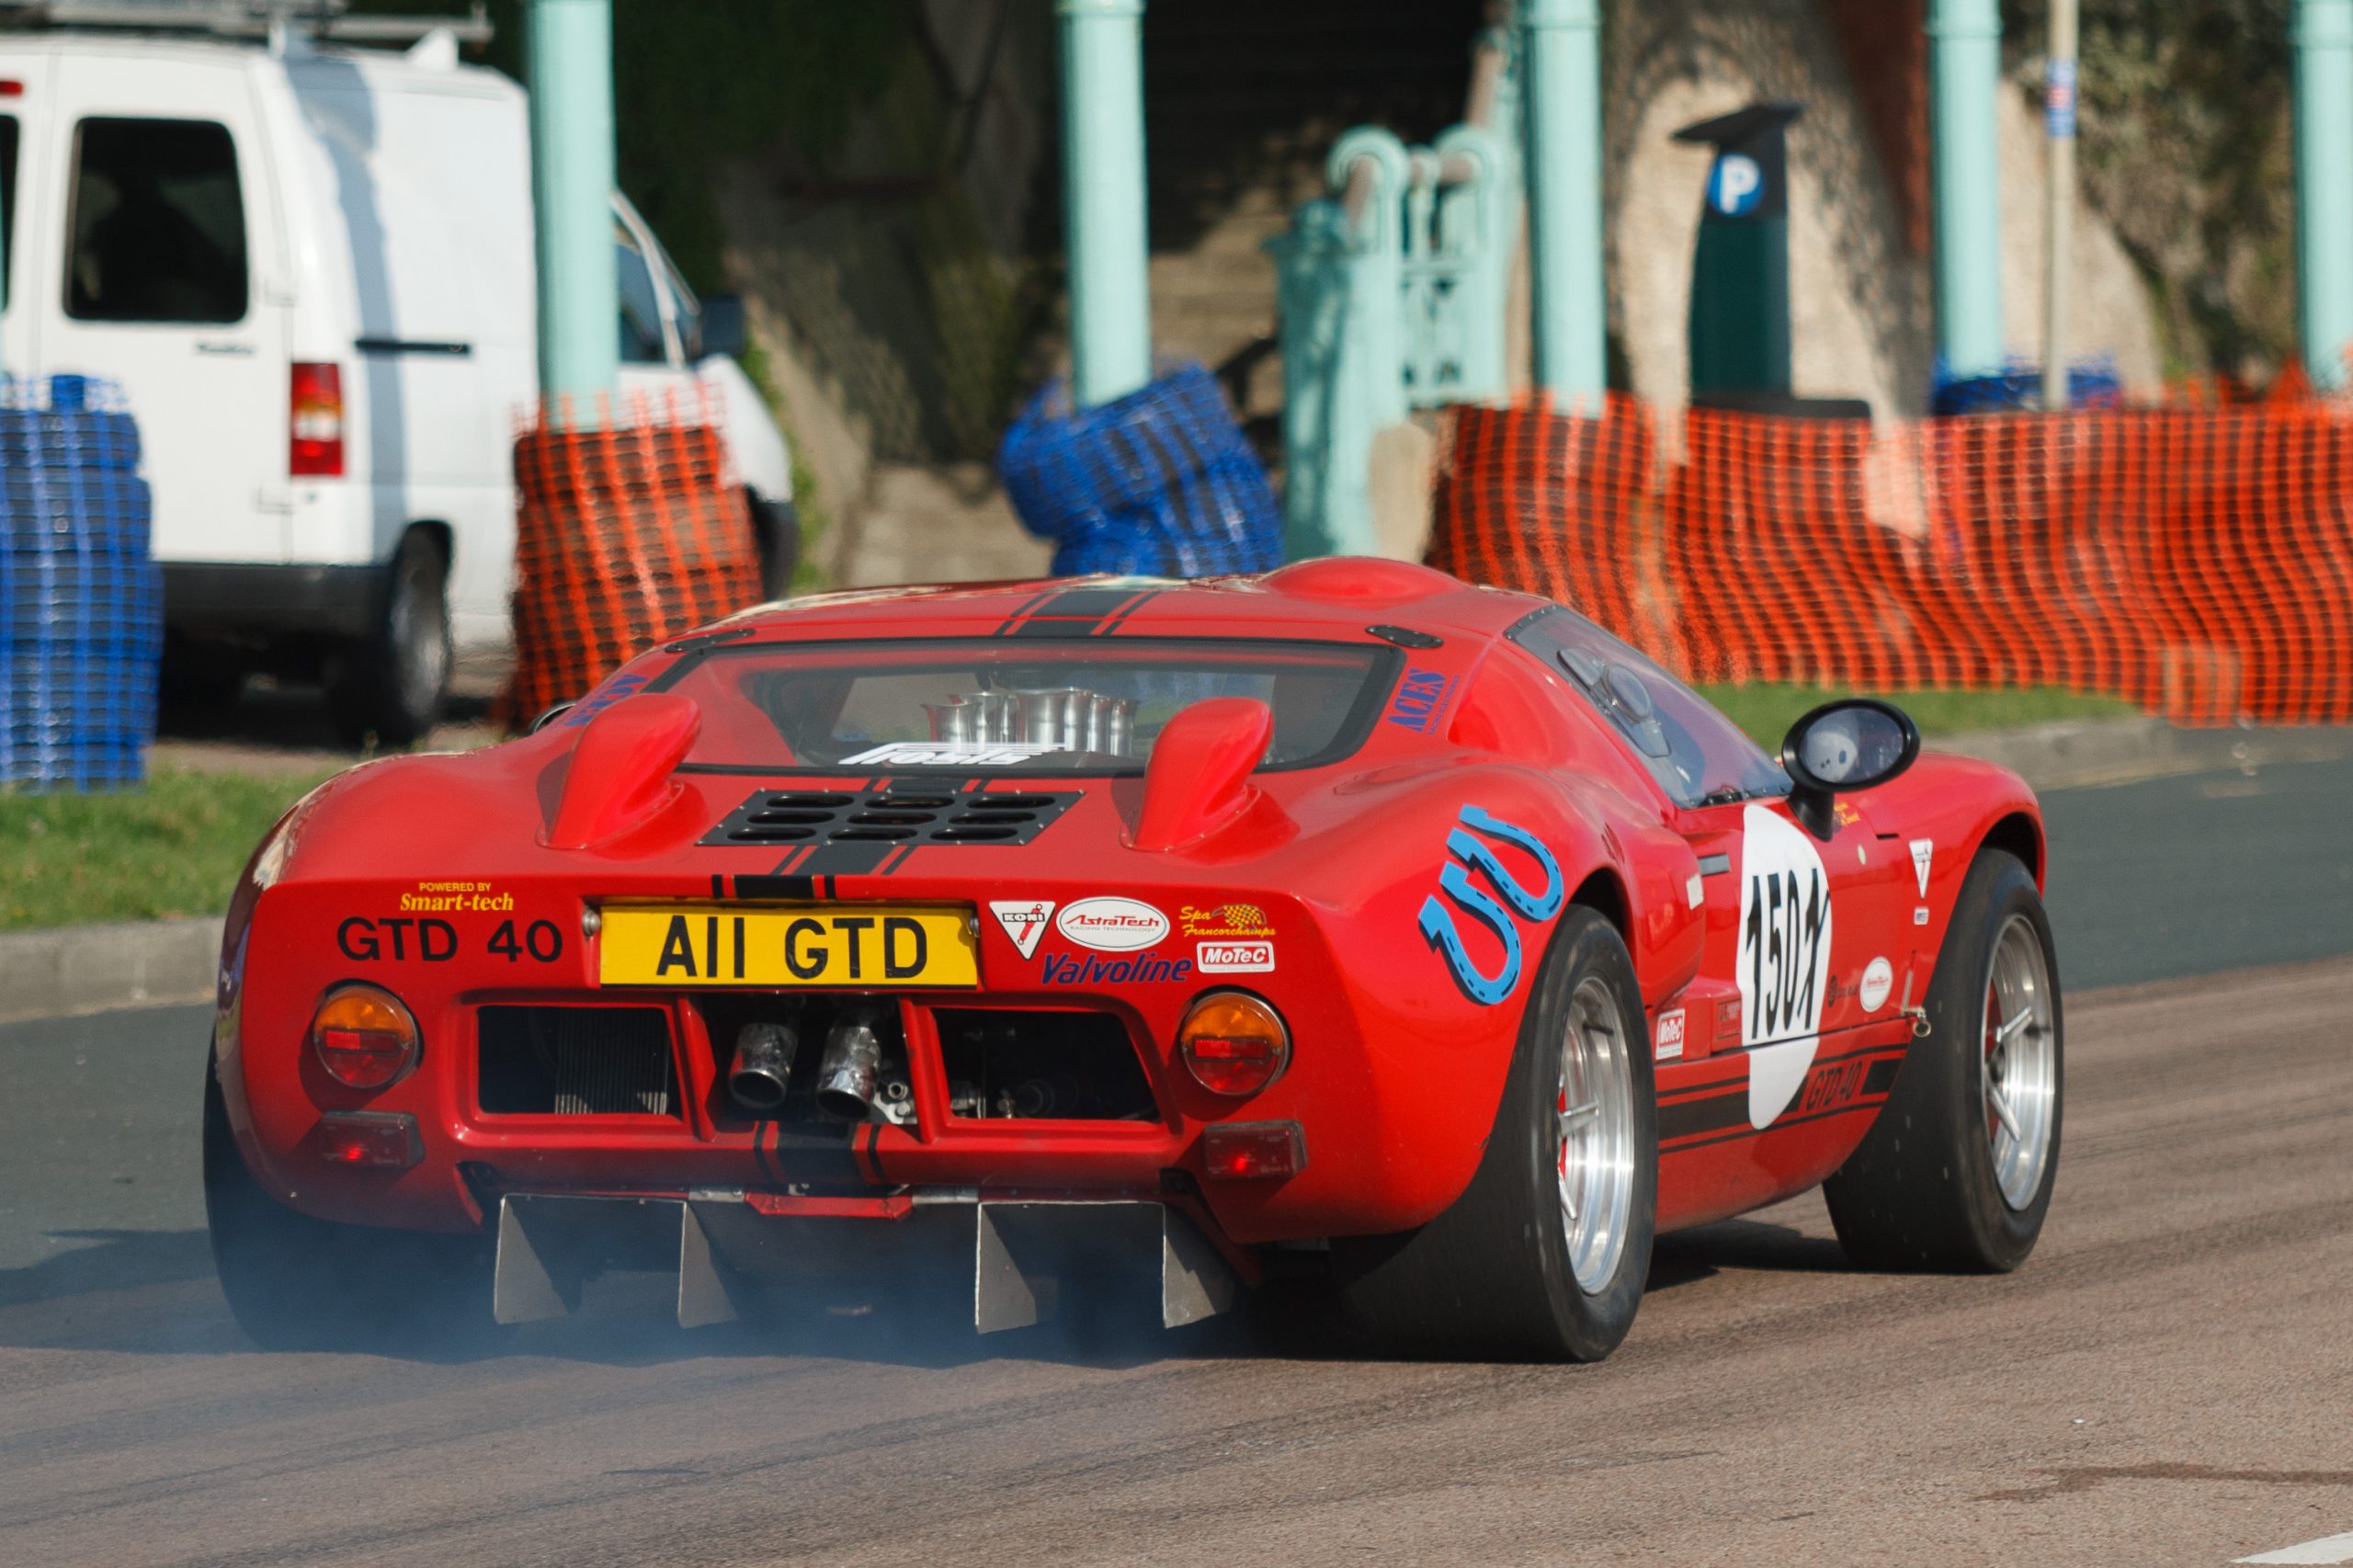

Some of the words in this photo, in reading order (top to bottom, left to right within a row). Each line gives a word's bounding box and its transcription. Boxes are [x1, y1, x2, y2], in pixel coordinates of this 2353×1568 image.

[1719, 153, 1761, 215] P
[419, 882, 474, 892] POWERED
[477, 882, 491, 892] BY
[400, 892, 514, 911] Smart-tech
[1002, 913, 1045, 923] KONI
[1065, 914, 1160, 927] AstraTech
[1178, 905, 1212, 923] Spa
[336, 916, 459, 962] GTD
[487, 919, 563, 962] 40
[1182, 924, 1276, 938] Francorchamps
[784, 916, 928, 980] GTD
[1204, 948, 1267, 964] MoTeC
[1040, 952, 1193, 985] Valvoline
